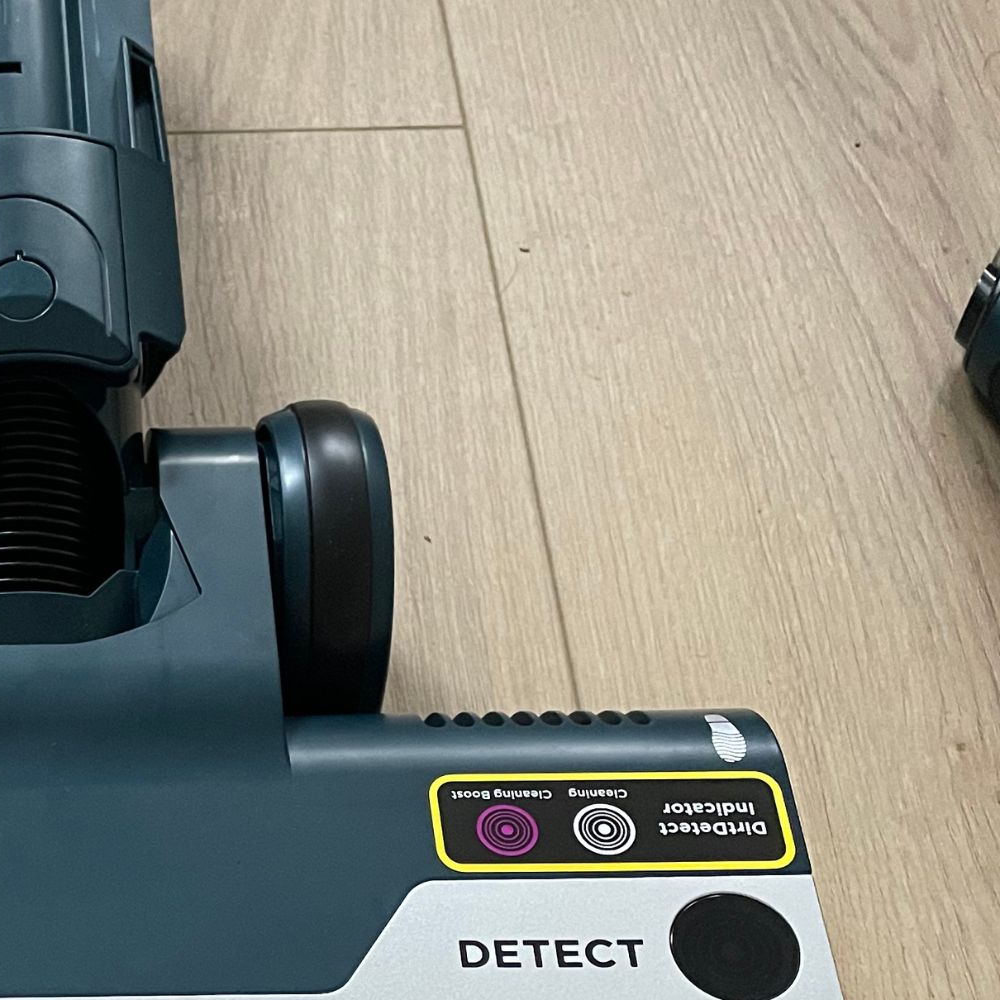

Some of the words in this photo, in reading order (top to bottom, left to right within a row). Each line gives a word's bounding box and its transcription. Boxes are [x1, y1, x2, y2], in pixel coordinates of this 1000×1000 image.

[451, 789, 490, 800] Boost
[493, 789, 552, 800] Cleaning
[568, 788, 628, 799] Cleaning
[662, 801, 755, 815] Indicator
[658, 820, 768, 836] DirtDetect
[458, 939, 644, 968] DETECT
